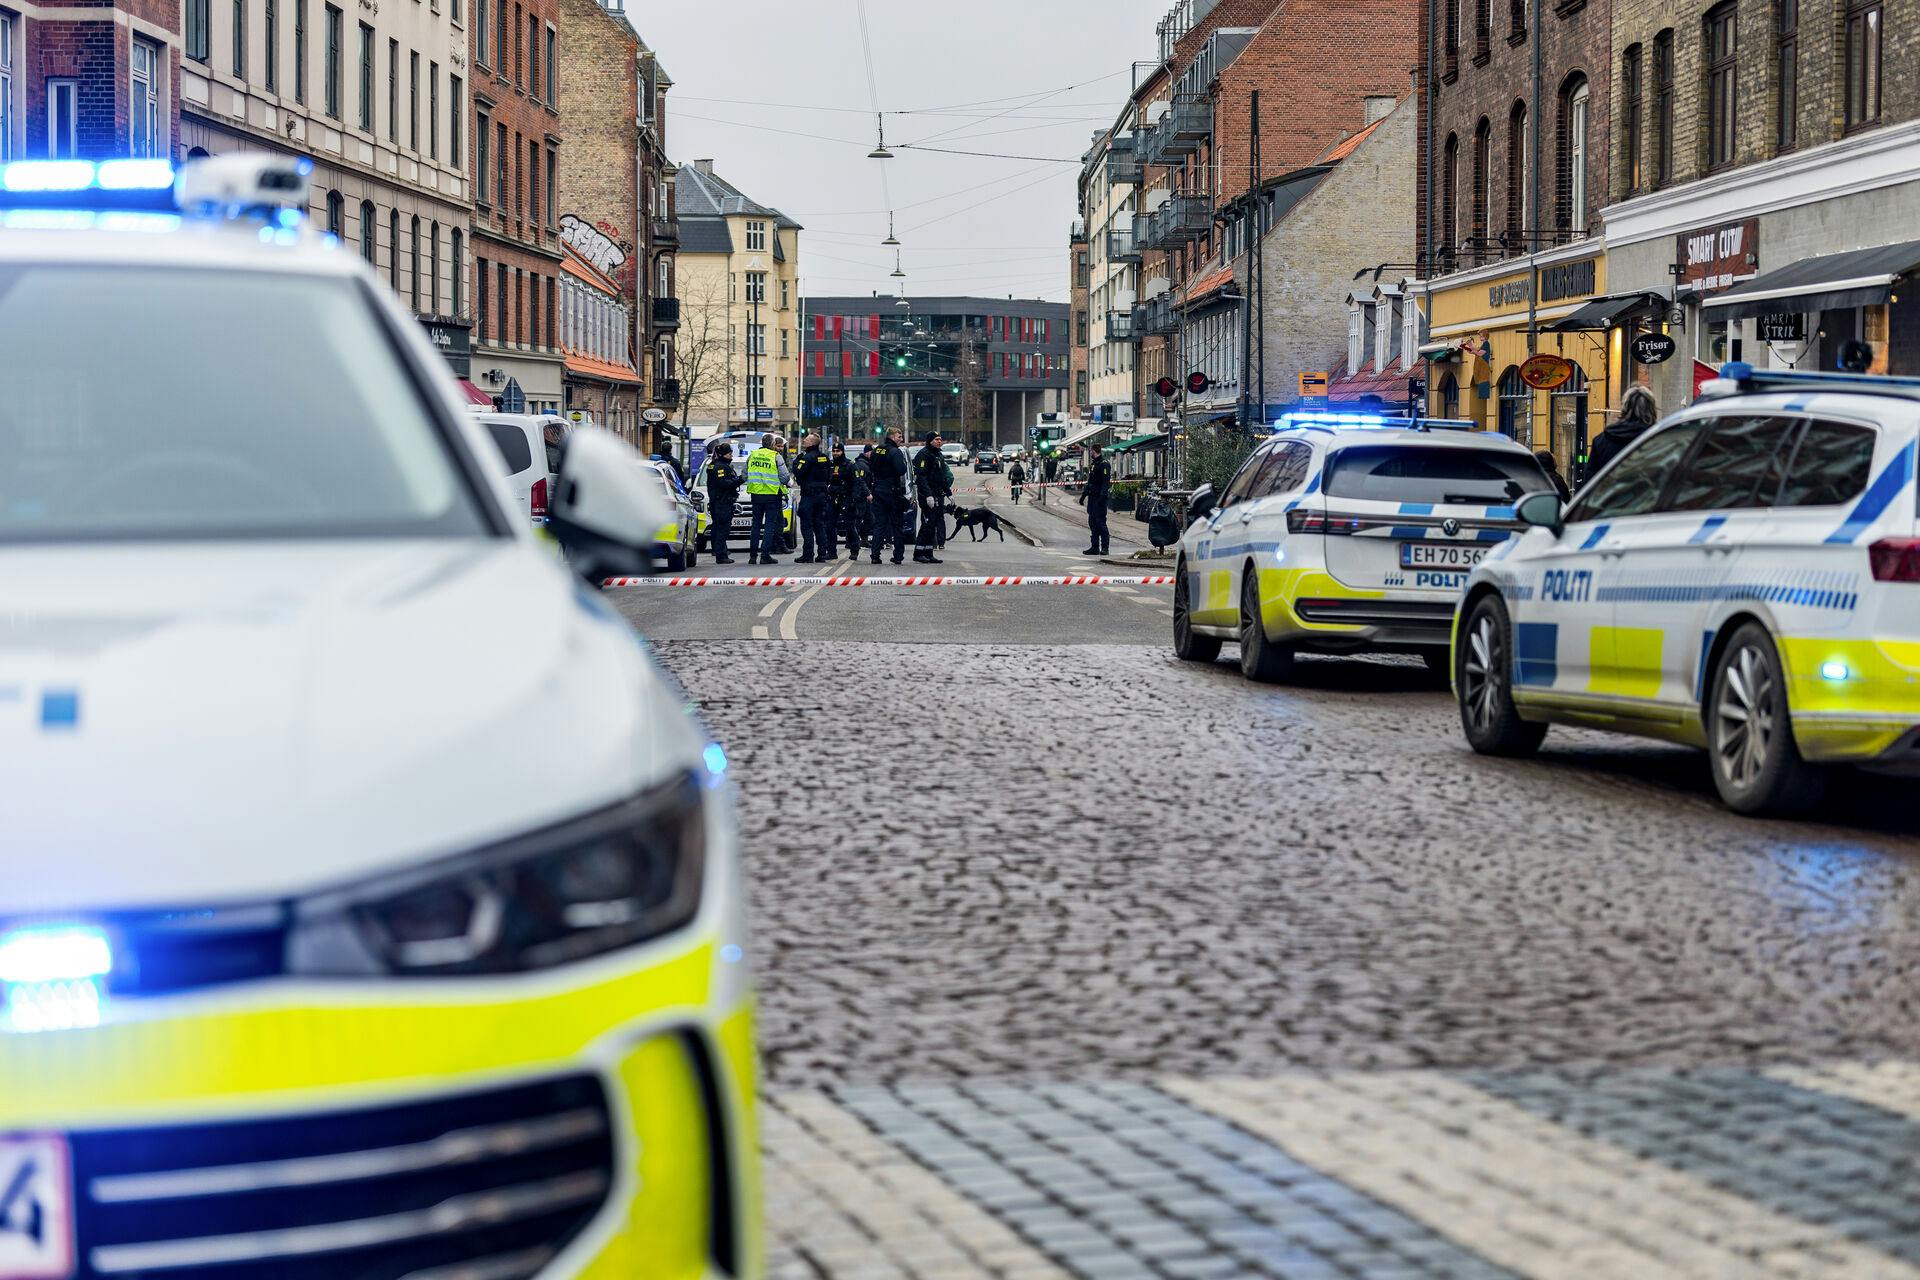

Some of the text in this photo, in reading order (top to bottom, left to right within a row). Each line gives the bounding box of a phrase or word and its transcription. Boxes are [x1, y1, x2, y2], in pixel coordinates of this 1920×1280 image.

[1688, 234, 1715, 265] SMART
[1764, 325, 1795, 338] STRIK
[1638, 340, 1669, 351] Frisør
[750, 461, 772, 469] POLITI
[1414, 547, 1435, 562] EH
[1439, 548, 1458, 563] 70
[1416, 572, 1469, 587] POLIT
[1541, 569, 1594, 601] POLITI
